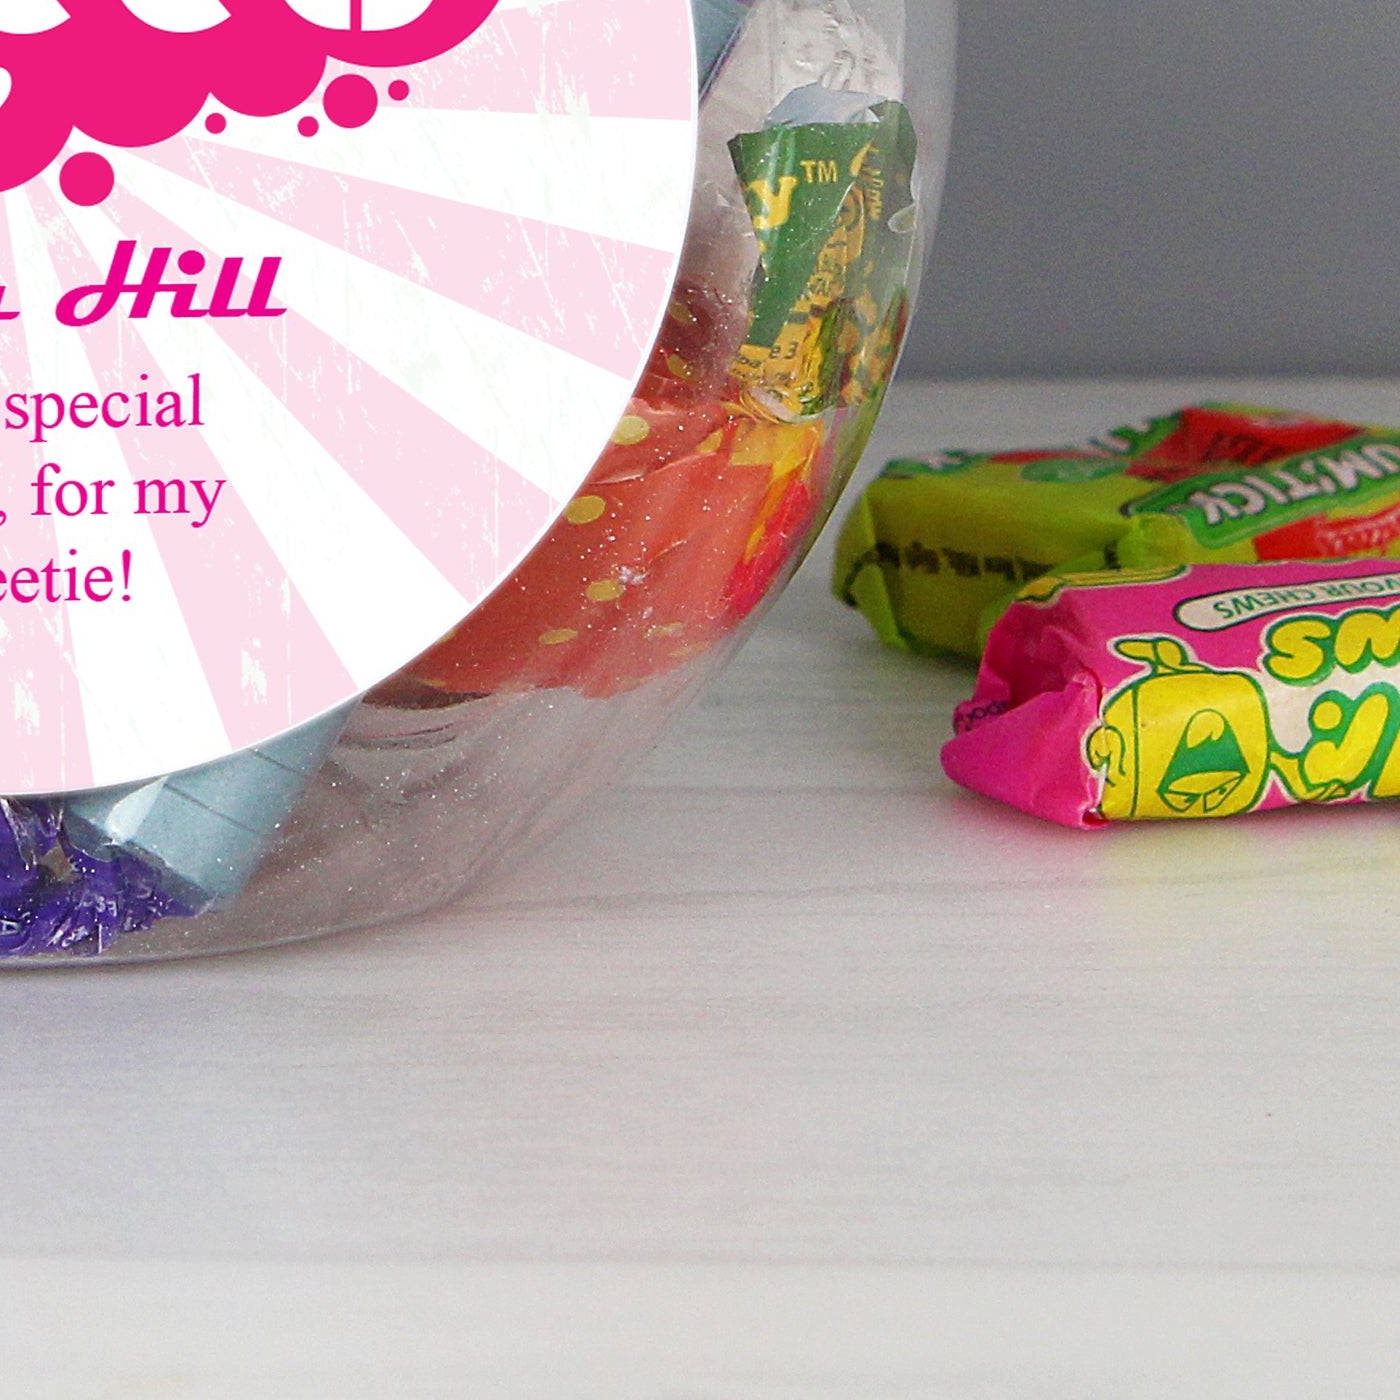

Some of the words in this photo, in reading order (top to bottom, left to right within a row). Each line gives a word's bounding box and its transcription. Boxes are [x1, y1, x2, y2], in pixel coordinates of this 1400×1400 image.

[56, 240, 288, 327] Hill
[6, 373, 204, 442] special
[31, 463, 115, 517] for
[134, 479, 227, 528] my
[1213, 588, 1317, 619] CHEWS
